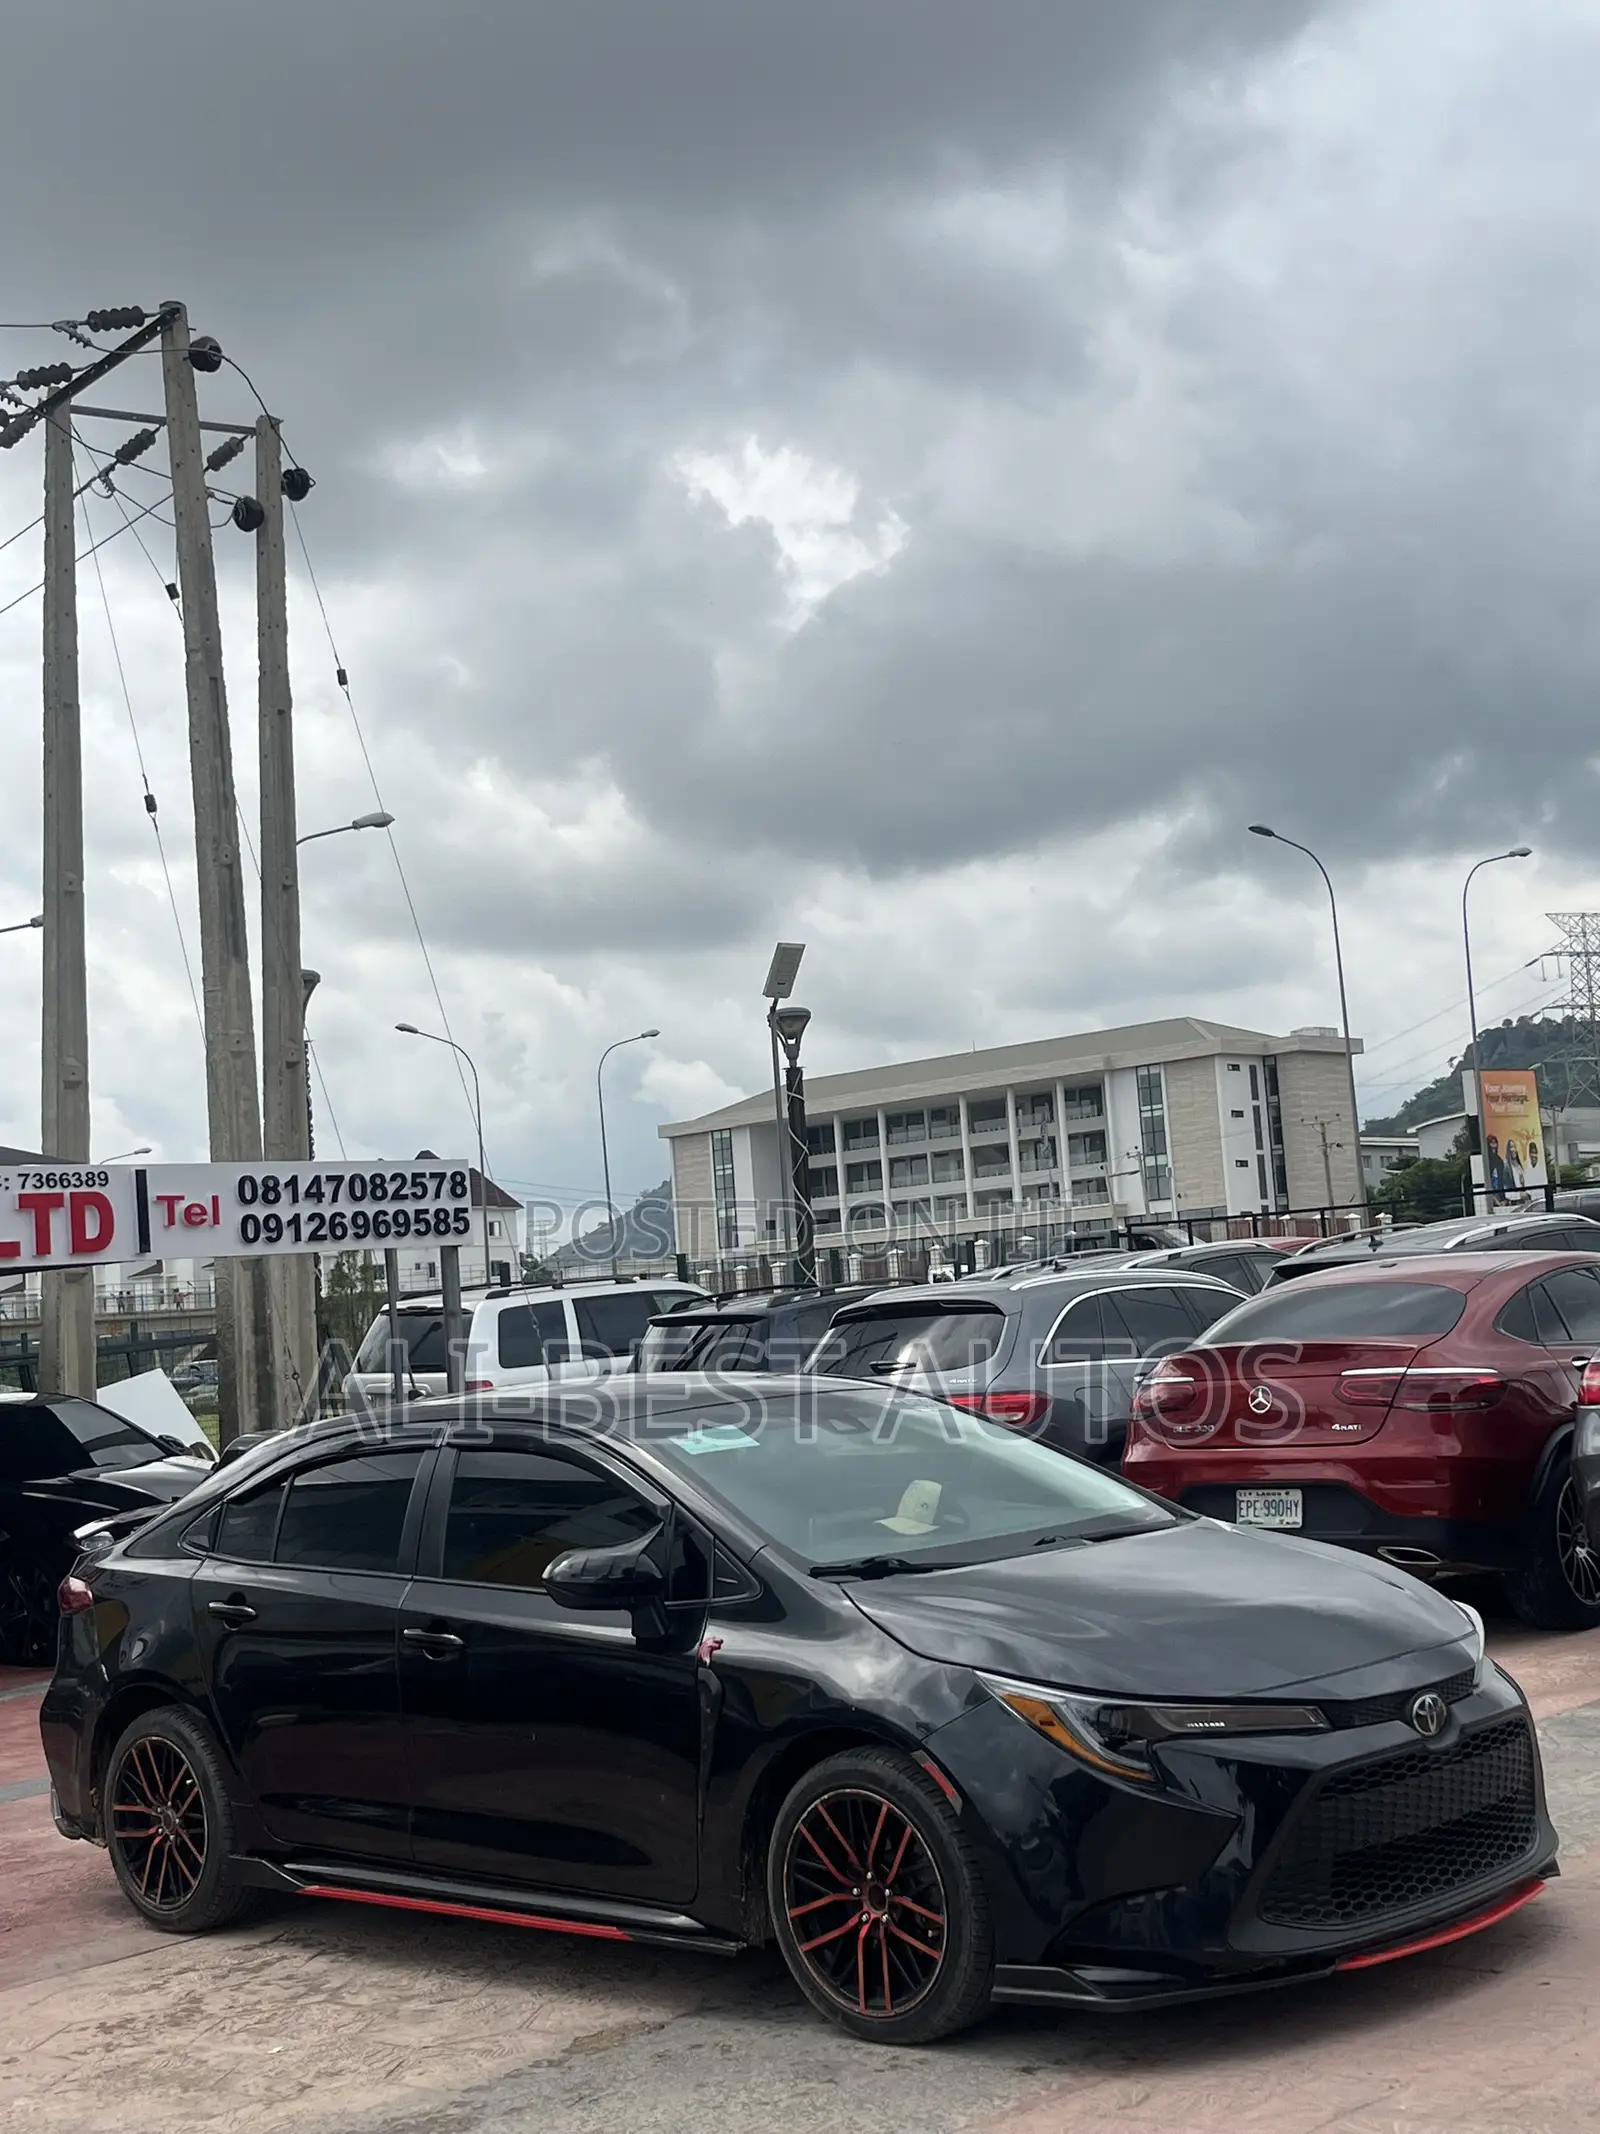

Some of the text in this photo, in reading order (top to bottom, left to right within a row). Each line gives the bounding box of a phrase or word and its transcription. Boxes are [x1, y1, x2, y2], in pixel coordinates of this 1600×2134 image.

[17, 1171, 109, 1190] 7366389
[237, 1170, 468, 1205] 08147082578
[155, 1195, 220, 1226] Tel
[240, 1207, 471, 1244] 09126969585
